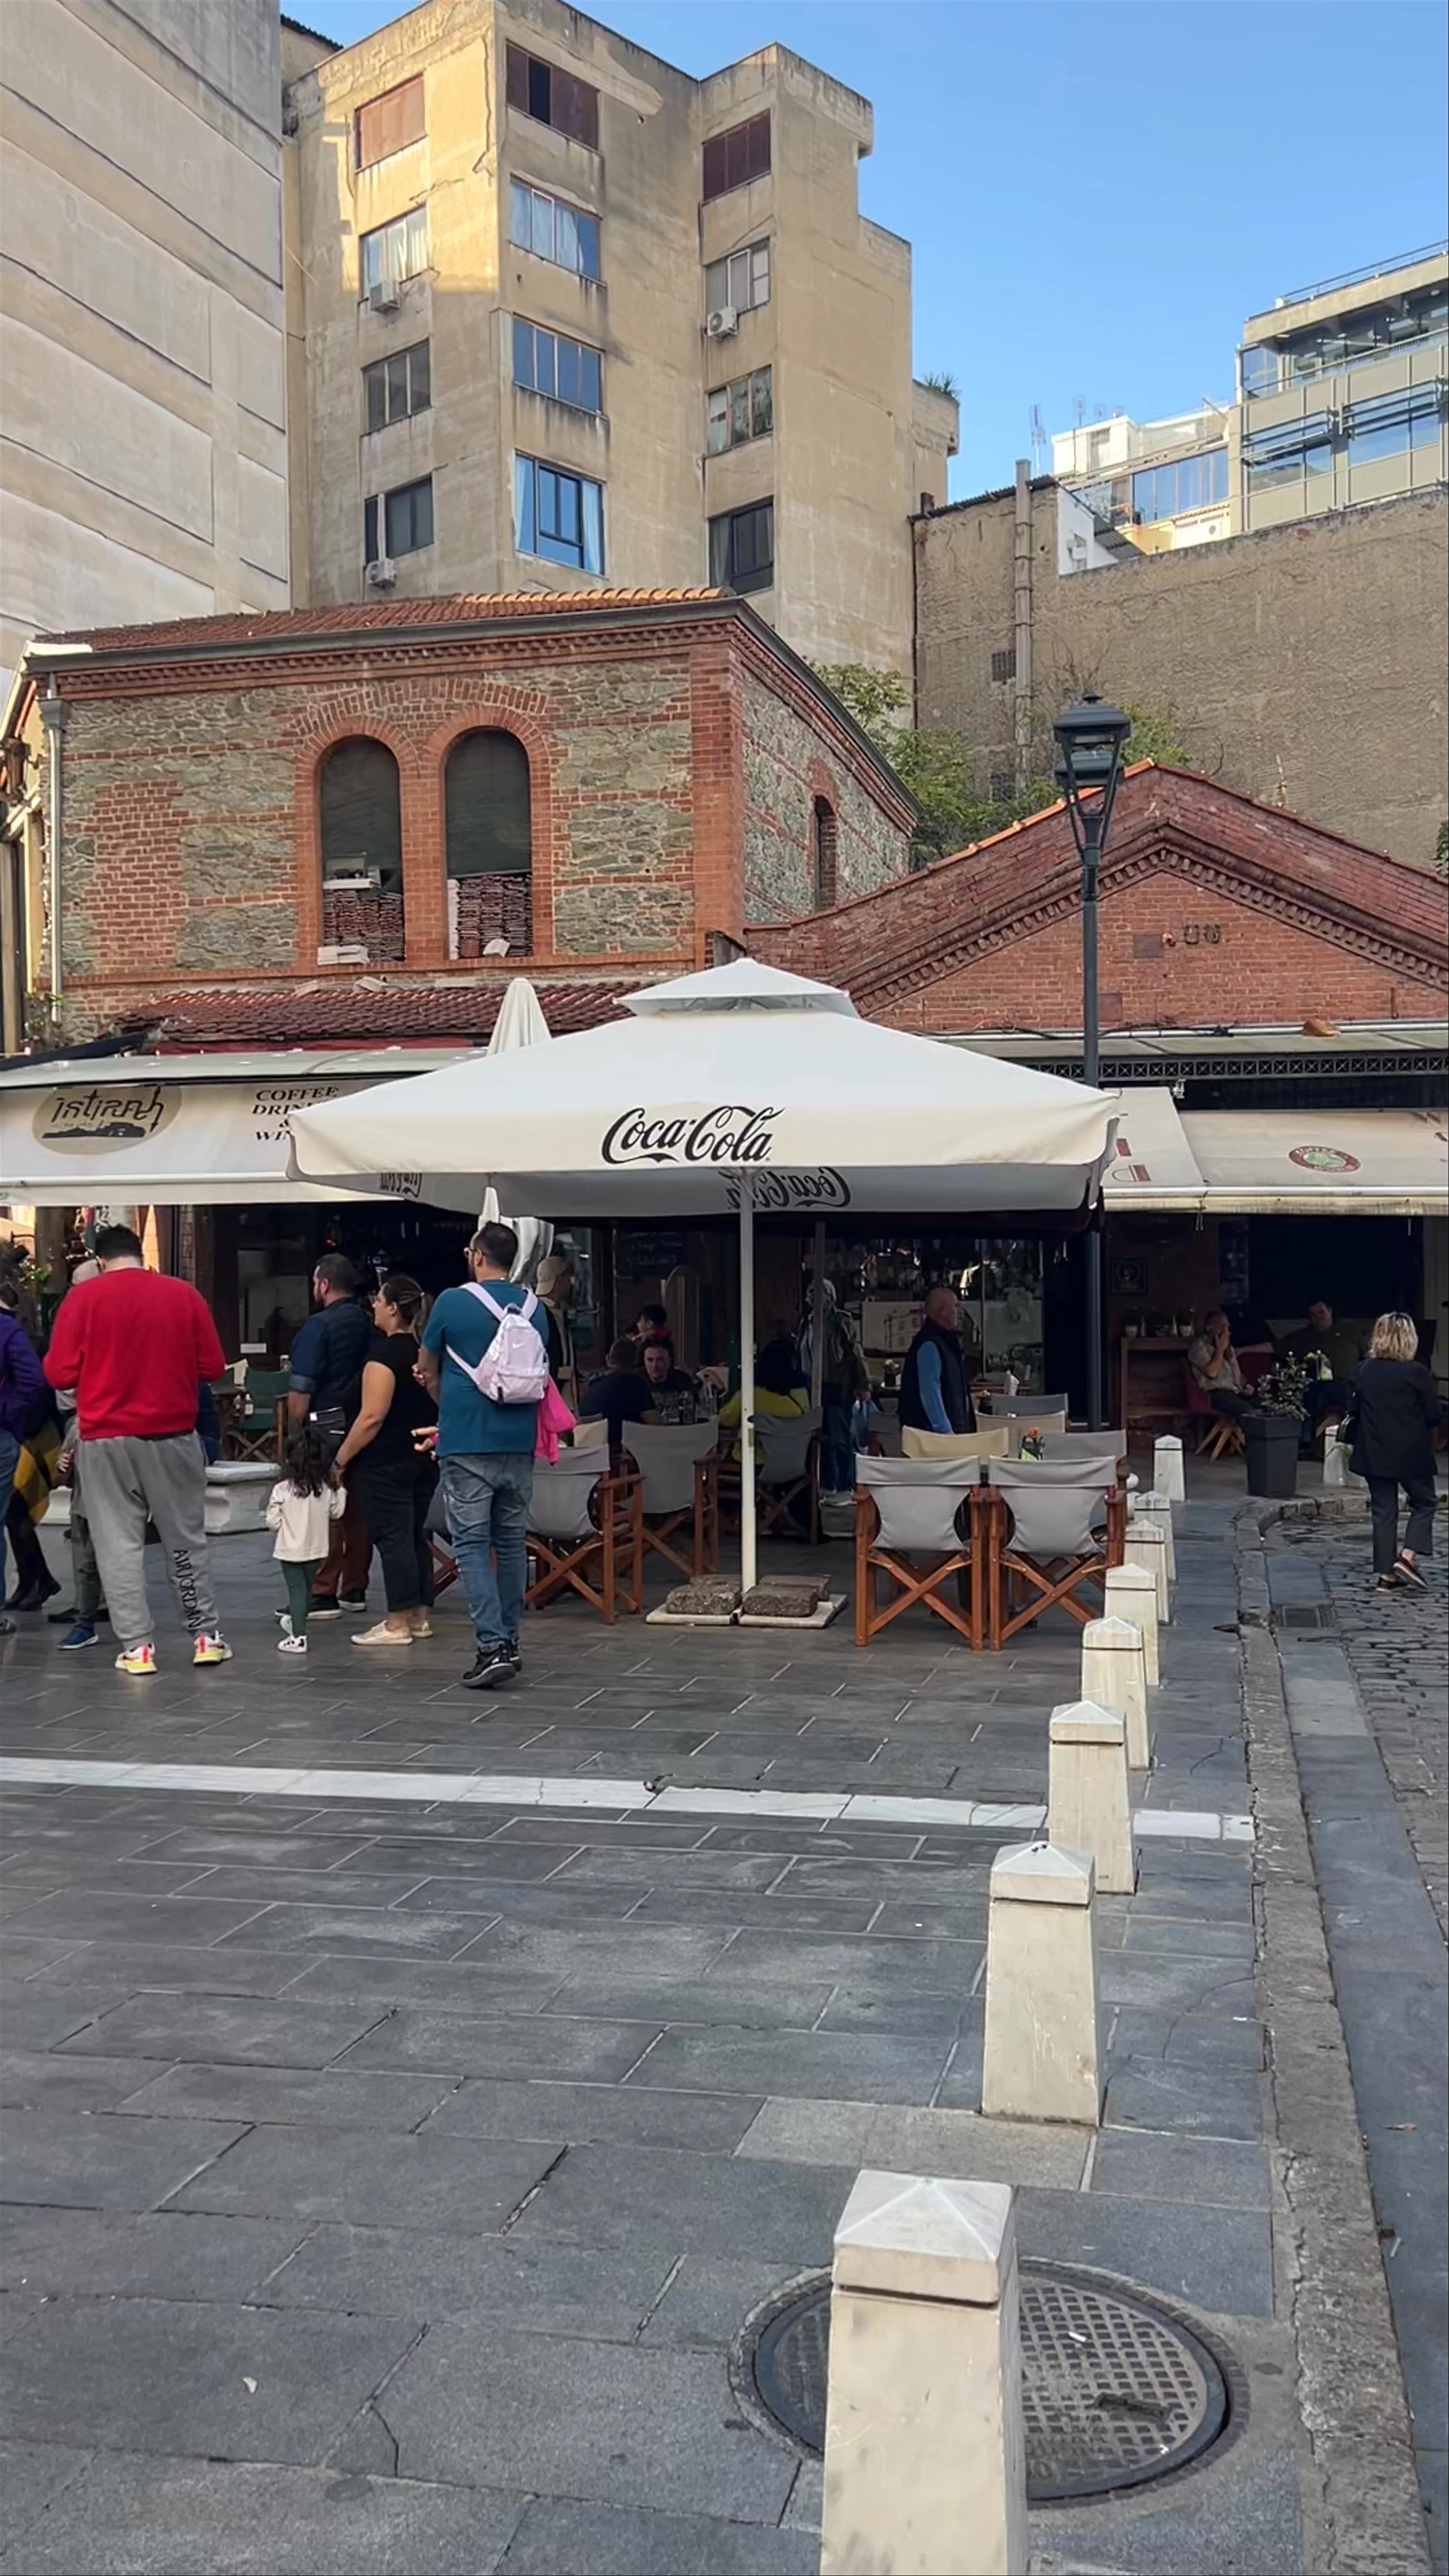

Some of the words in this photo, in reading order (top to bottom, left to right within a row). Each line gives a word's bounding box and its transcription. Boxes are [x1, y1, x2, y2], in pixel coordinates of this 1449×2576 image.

[256, 1086, 340, 1101] COFFEE
[252, 1101, 325, 1115] DRIN
[173, 1550, 192, 1573] AIR
[176, 1573, 202, 1628] JORDAN
